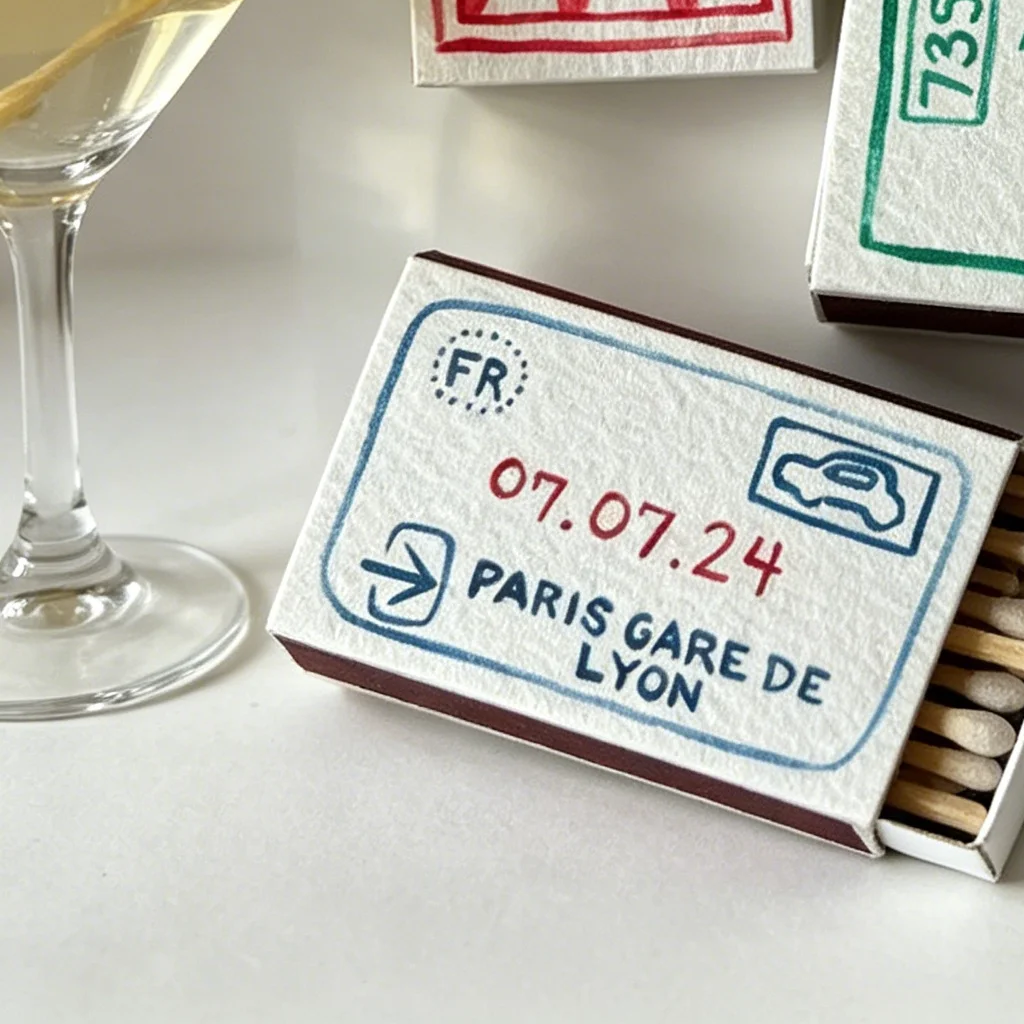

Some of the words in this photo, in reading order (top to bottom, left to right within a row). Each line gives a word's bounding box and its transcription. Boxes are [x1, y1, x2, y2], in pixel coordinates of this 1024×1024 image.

[445, 348, 508, 403] FR
[488, 456, 785, 598] 07.07.24
[467, 558, 616, 637] PARIS
[624, 612, 748, 681] GARE
[763, 653, 831, 706] DE
[575, 638, 703, 714] LYON
